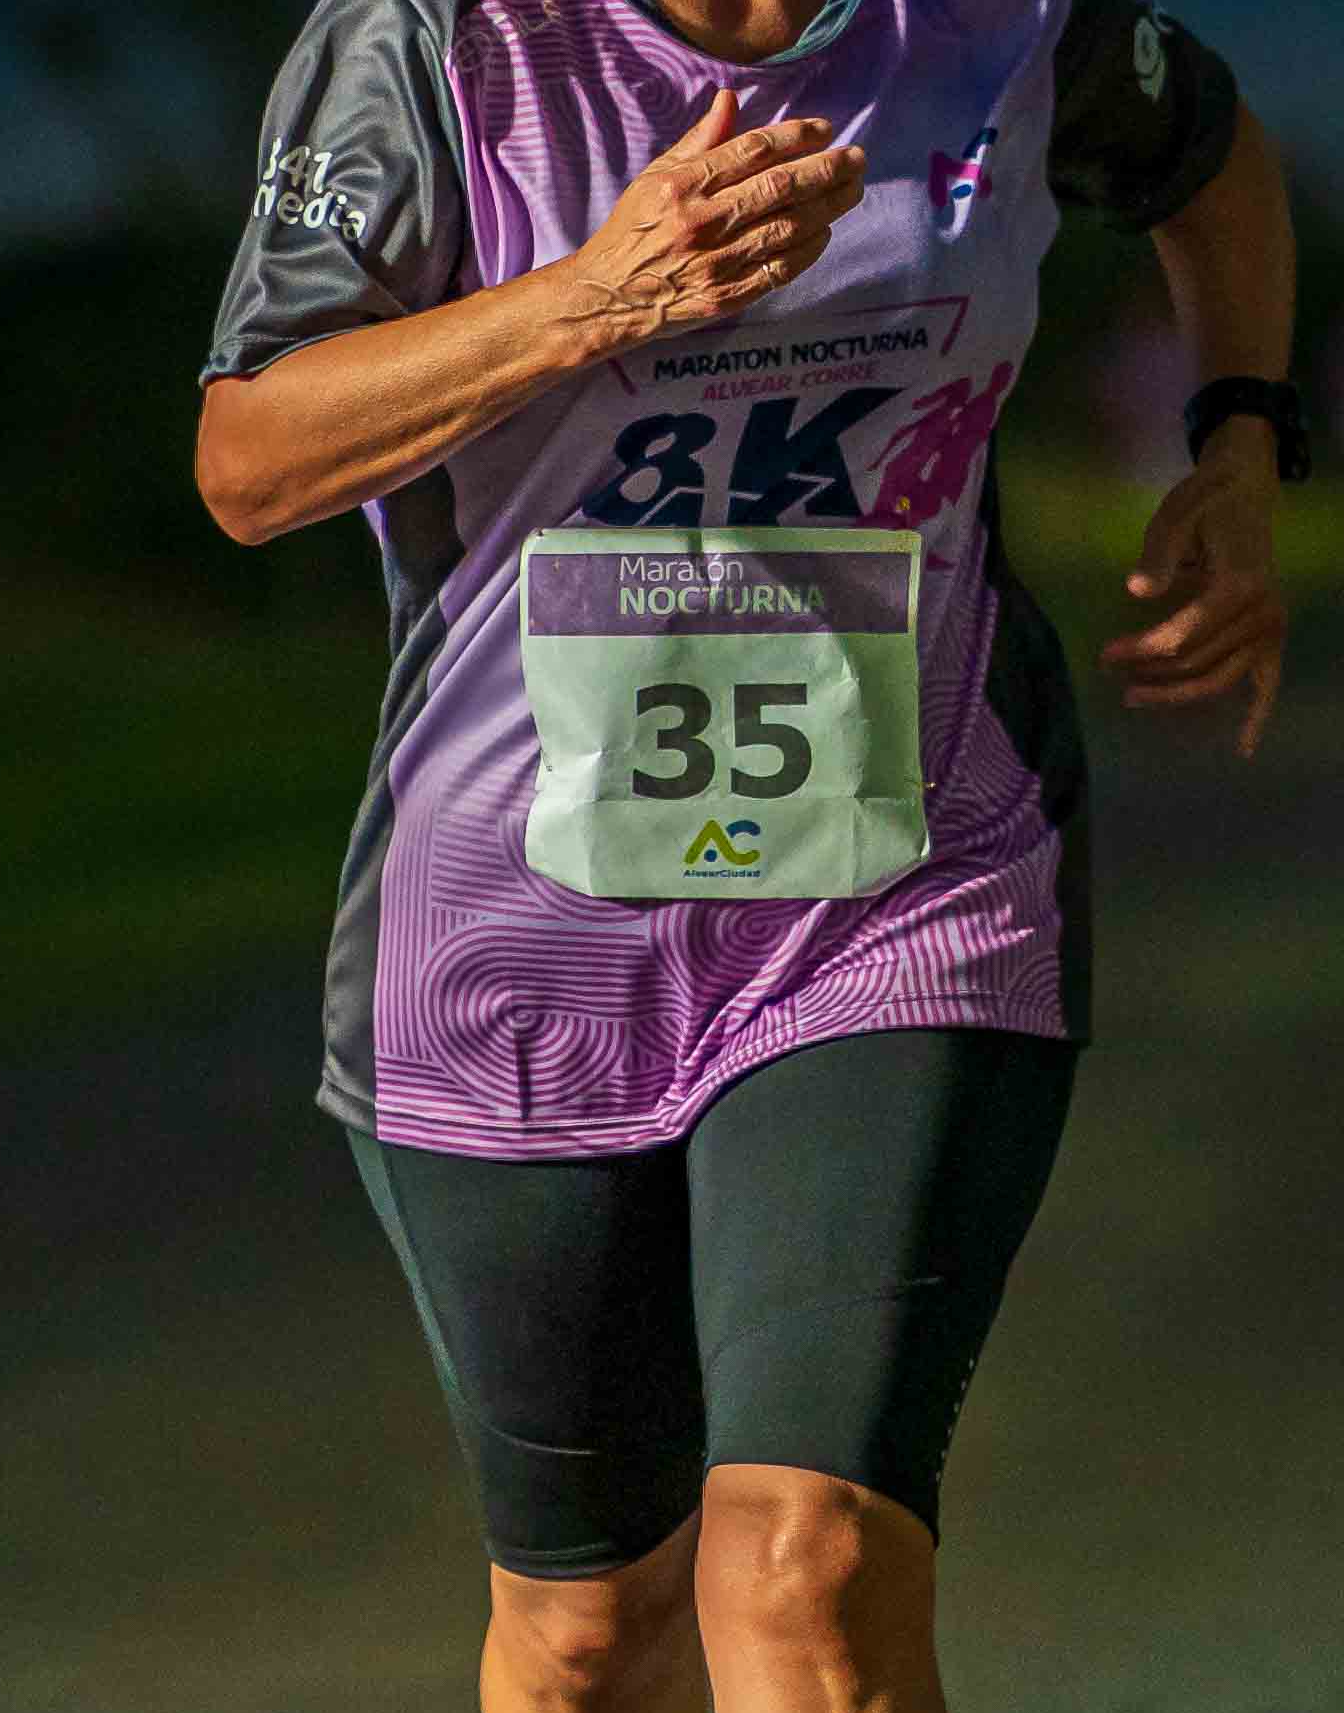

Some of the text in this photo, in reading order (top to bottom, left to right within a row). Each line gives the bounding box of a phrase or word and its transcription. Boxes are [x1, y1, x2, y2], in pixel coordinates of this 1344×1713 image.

[655, 328, 929, 379] MARATON NOCTURNA
[704, 361, 880, 400] ALVEAR CORRE
[619, 552, 744, 582] Maratón
[619, 585, 825, 616] NOCTURNA
[632, 683, 813, 800] 35
